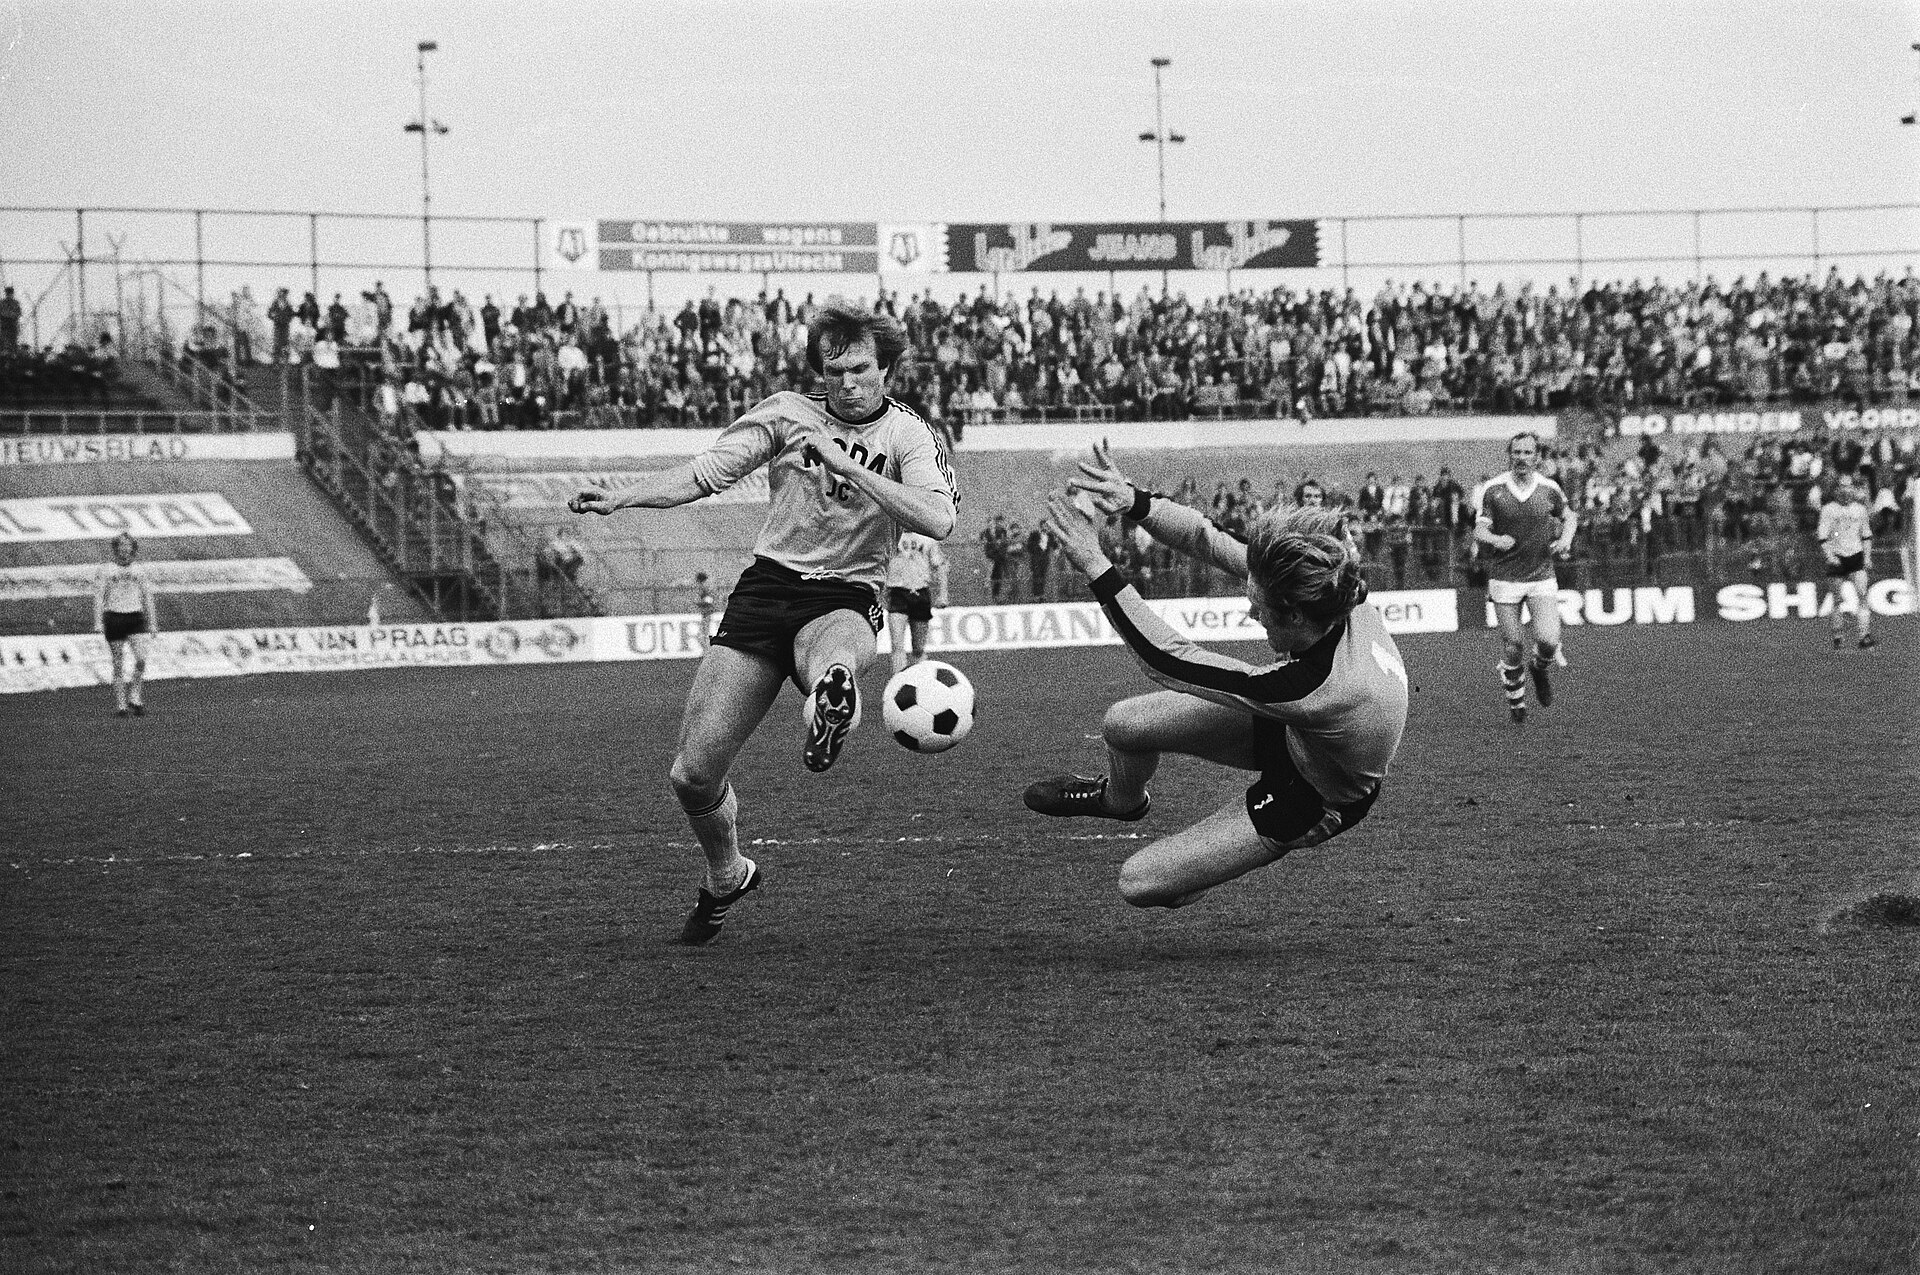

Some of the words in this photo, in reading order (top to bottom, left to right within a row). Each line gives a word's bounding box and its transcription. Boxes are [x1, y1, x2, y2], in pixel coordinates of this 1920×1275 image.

[826, 478, 850, 501] JC
[47, 499, 236, 533] TOTAL
[252, 633, 300, 651] MAX
[309, 631, 358, 651] VAN
[370, 626, 469, 650] PRAAG
